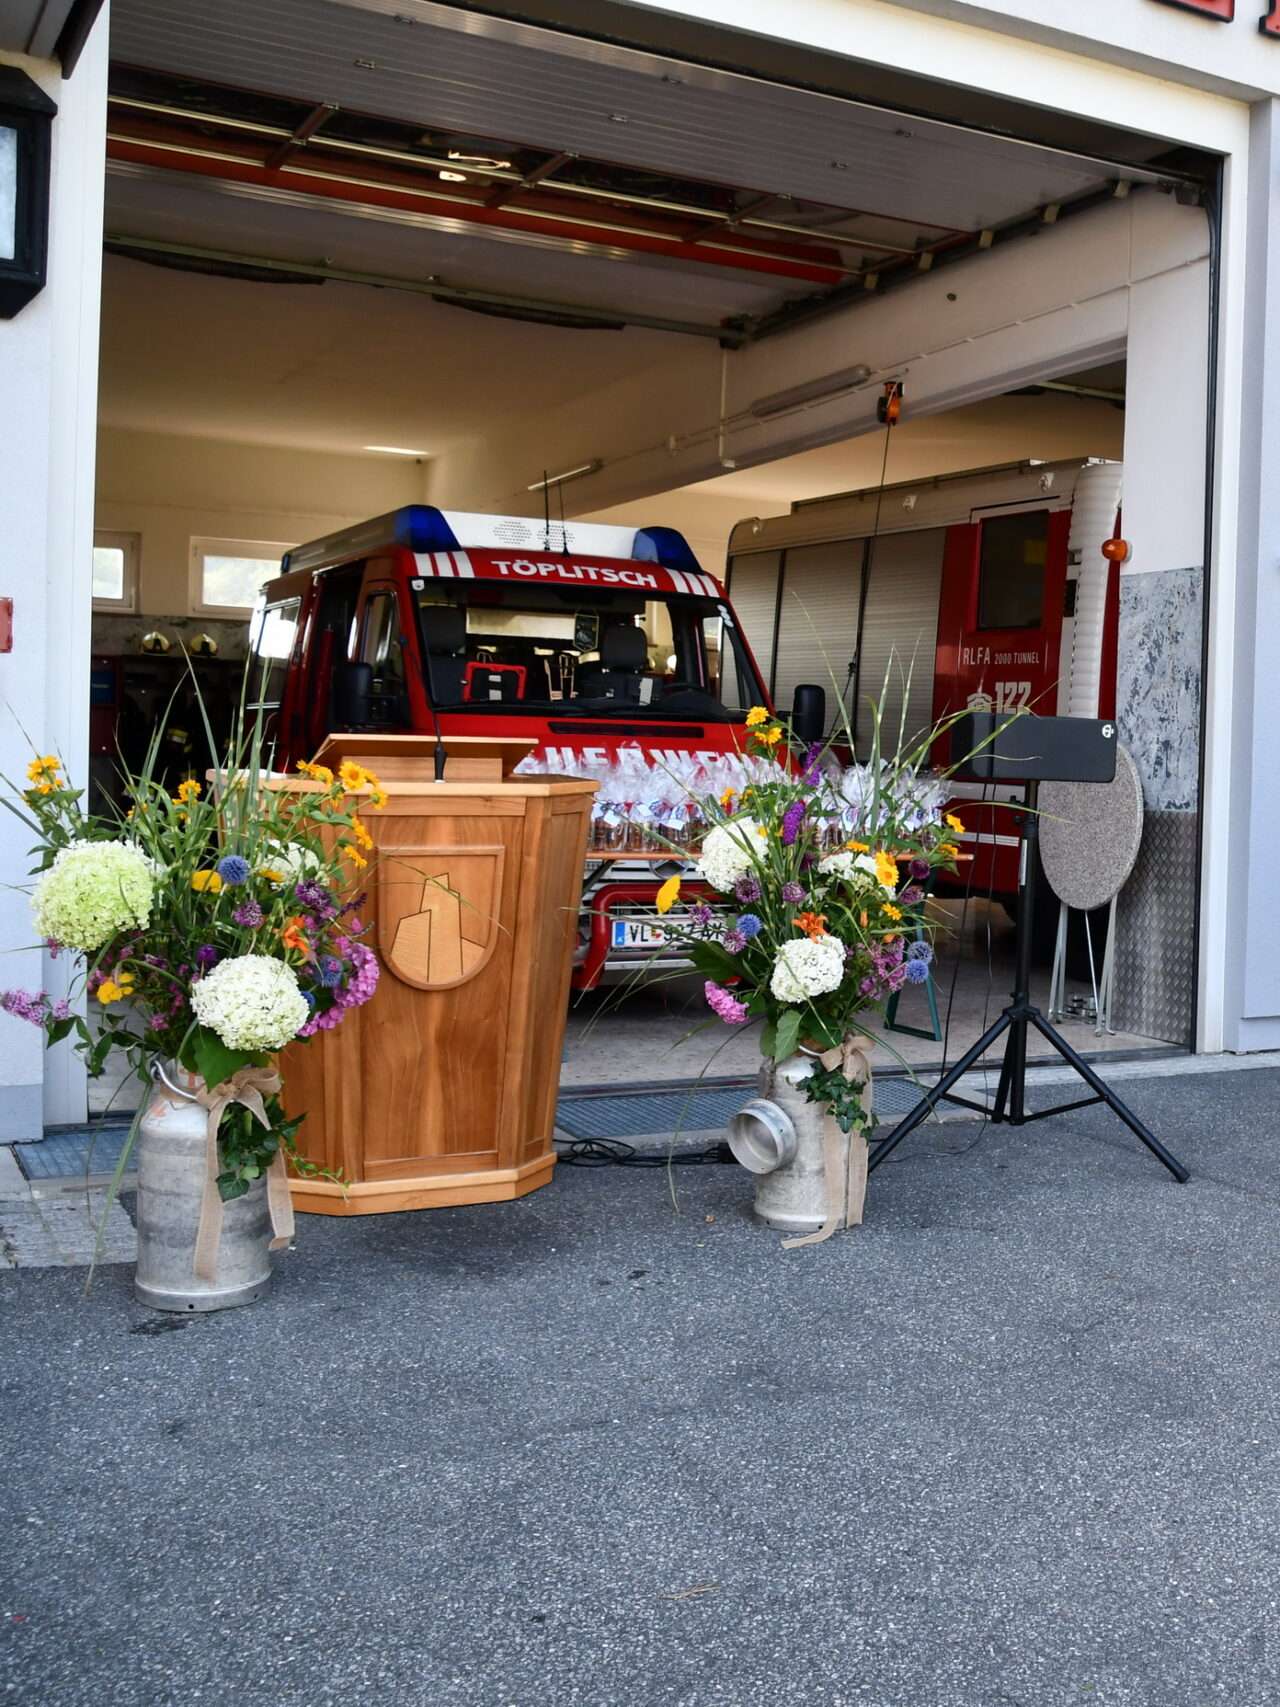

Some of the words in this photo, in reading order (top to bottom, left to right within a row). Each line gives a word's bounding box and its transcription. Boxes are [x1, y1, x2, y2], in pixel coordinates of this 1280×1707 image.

[490, 559, 658, 588] TÖPLITSCH
[962, 647, 991, 665] RLFA
[1013, 651, 1040, 664] TUNNEL
[995, 681, 1032, 715] 122
